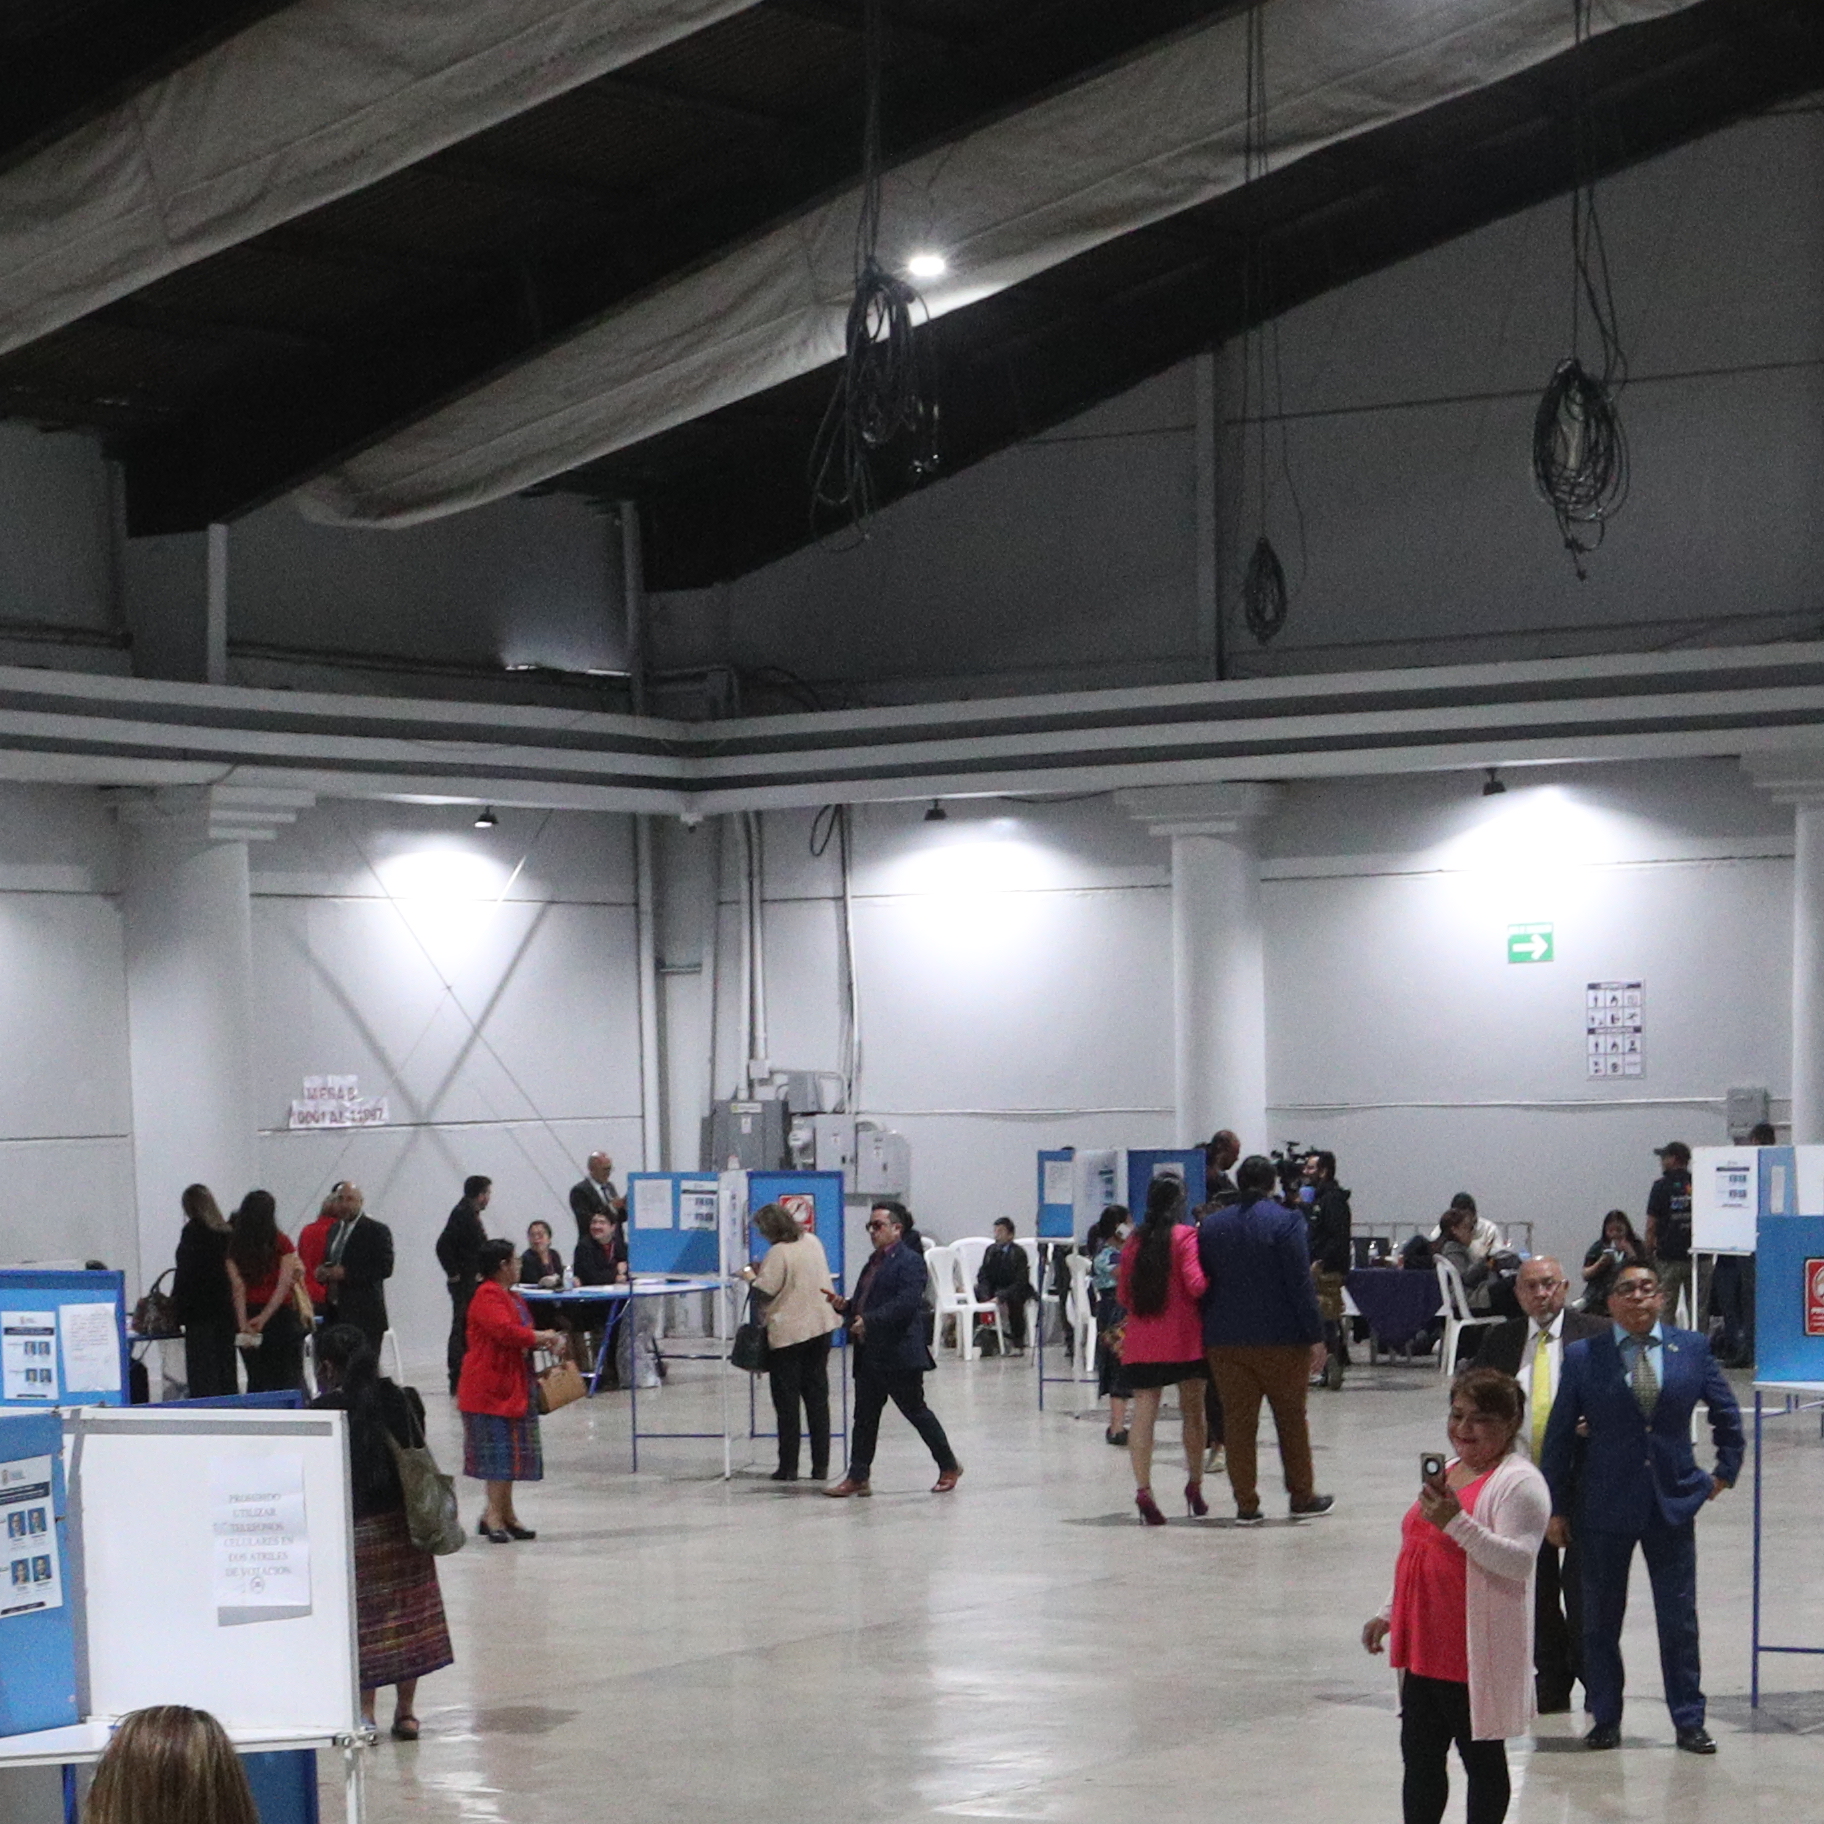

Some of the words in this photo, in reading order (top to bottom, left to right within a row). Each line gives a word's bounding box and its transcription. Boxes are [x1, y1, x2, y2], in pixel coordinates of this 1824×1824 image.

[306, 1086, 345, 1100] MESA
[232, 1508, 276, 1518] UTILIZAR
[224, 1536, 280, 1547] CELULARES
